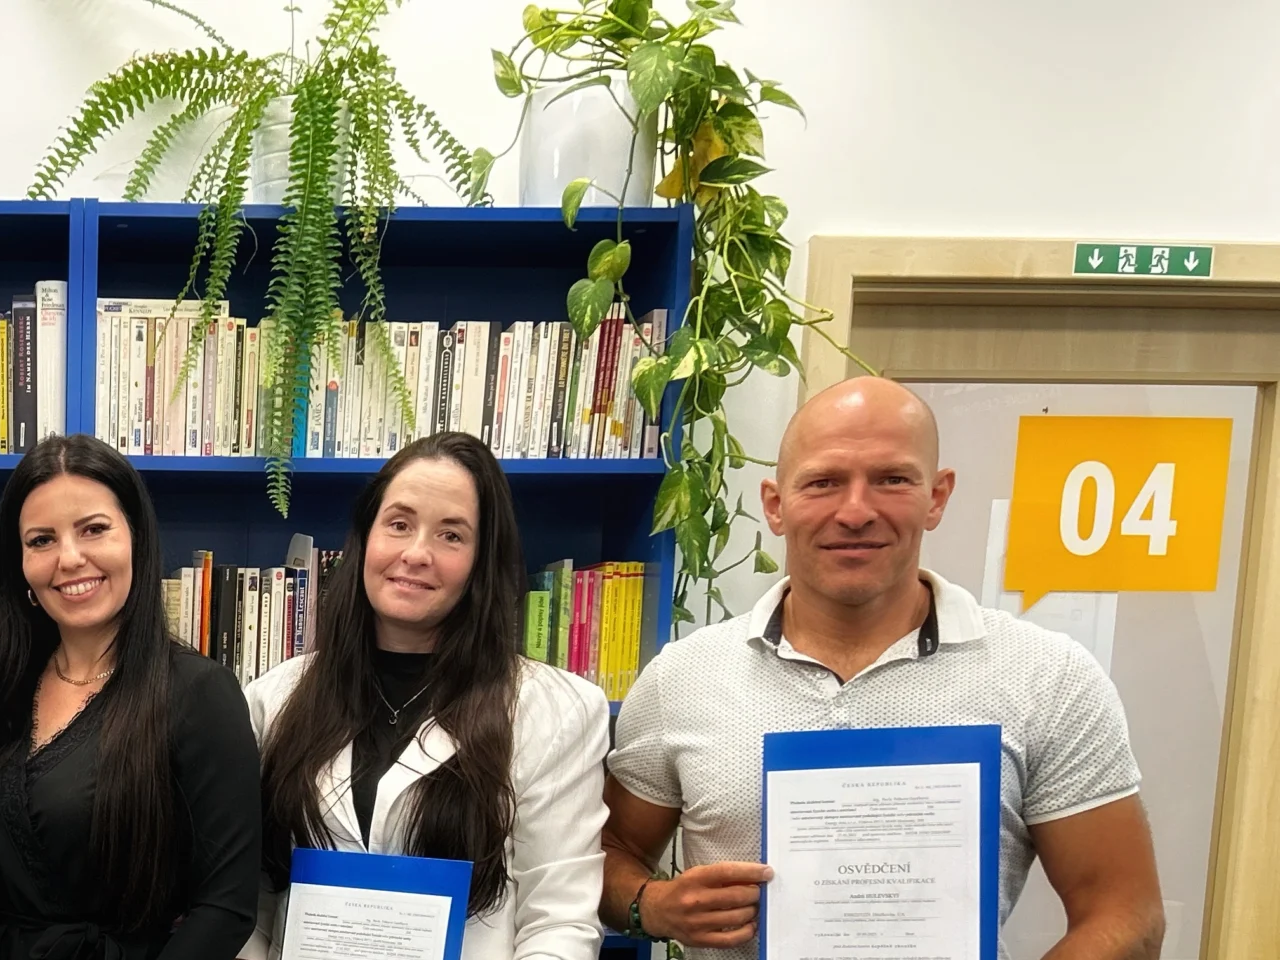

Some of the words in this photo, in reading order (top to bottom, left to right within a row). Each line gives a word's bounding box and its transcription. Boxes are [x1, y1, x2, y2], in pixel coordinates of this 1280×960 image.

[314, 402, 323, 426] JAMES
[1060, 460, 1178, 556] 04
[297, 586, 305, 612] Lescaut
[296, 612, 304, 636] Manon
[837, 861, 912, 875] OSVĚDČENÍ
[821, 877, 850, 886] ZÍSKÁNÍ
[851, 877, 886, 885] PROFESNÍ
[887, 876, 936, 885] KVALIFIKACE
